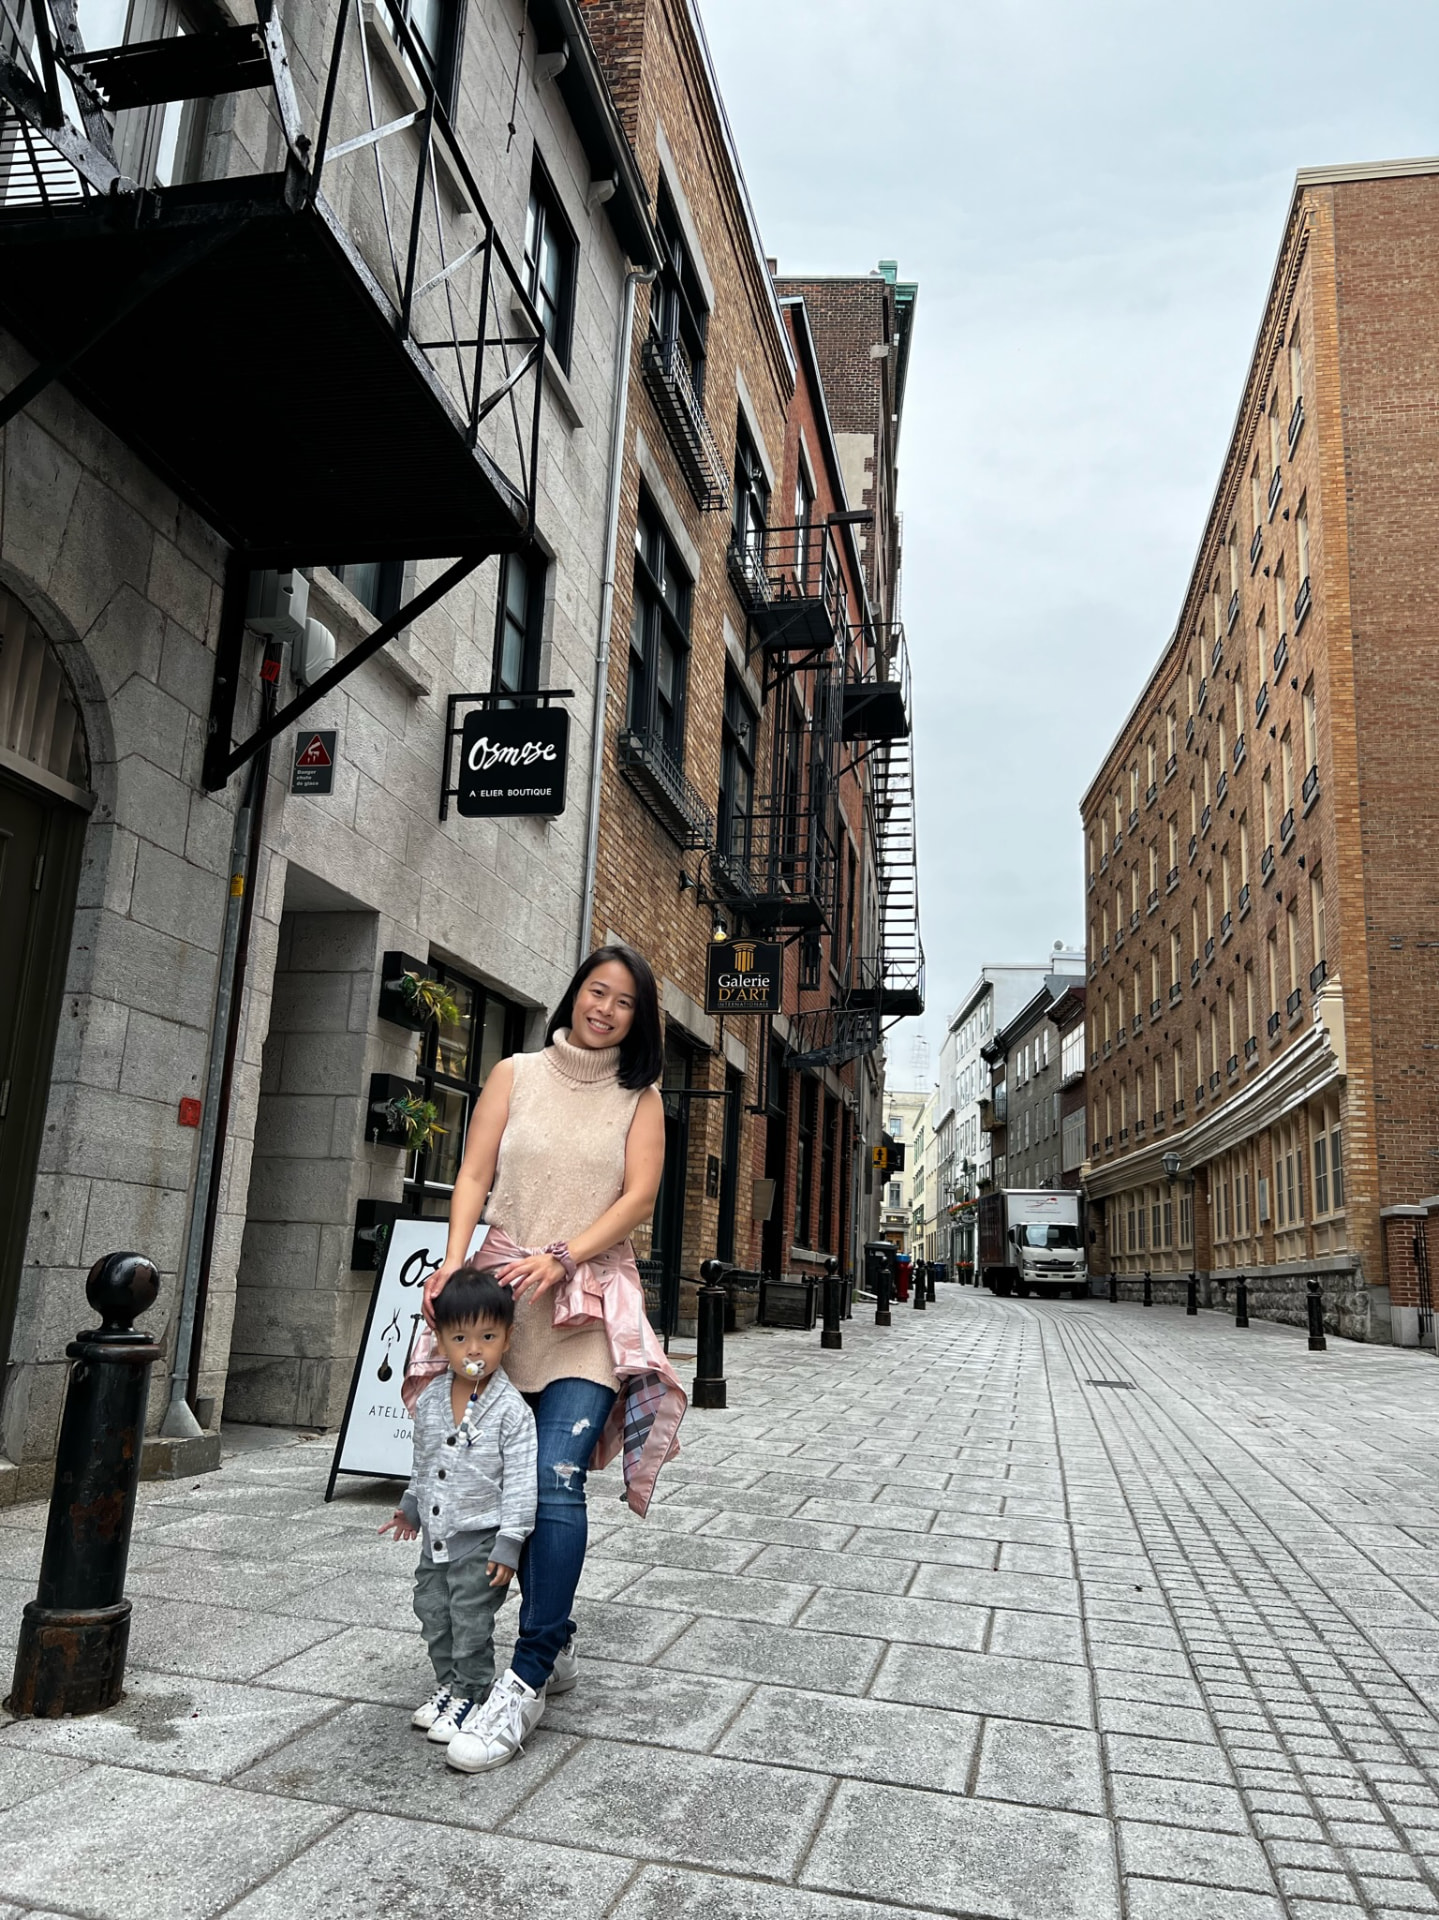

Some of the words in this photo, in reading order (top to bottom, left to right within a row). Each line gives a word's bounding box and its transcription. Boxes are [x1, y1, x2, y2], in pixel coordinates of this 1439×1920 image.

[468, 737, 557, 771] Osmose
[507, 788, 552, 797] BOUTIQUE
[718, 974, 770, 988] Galerie
